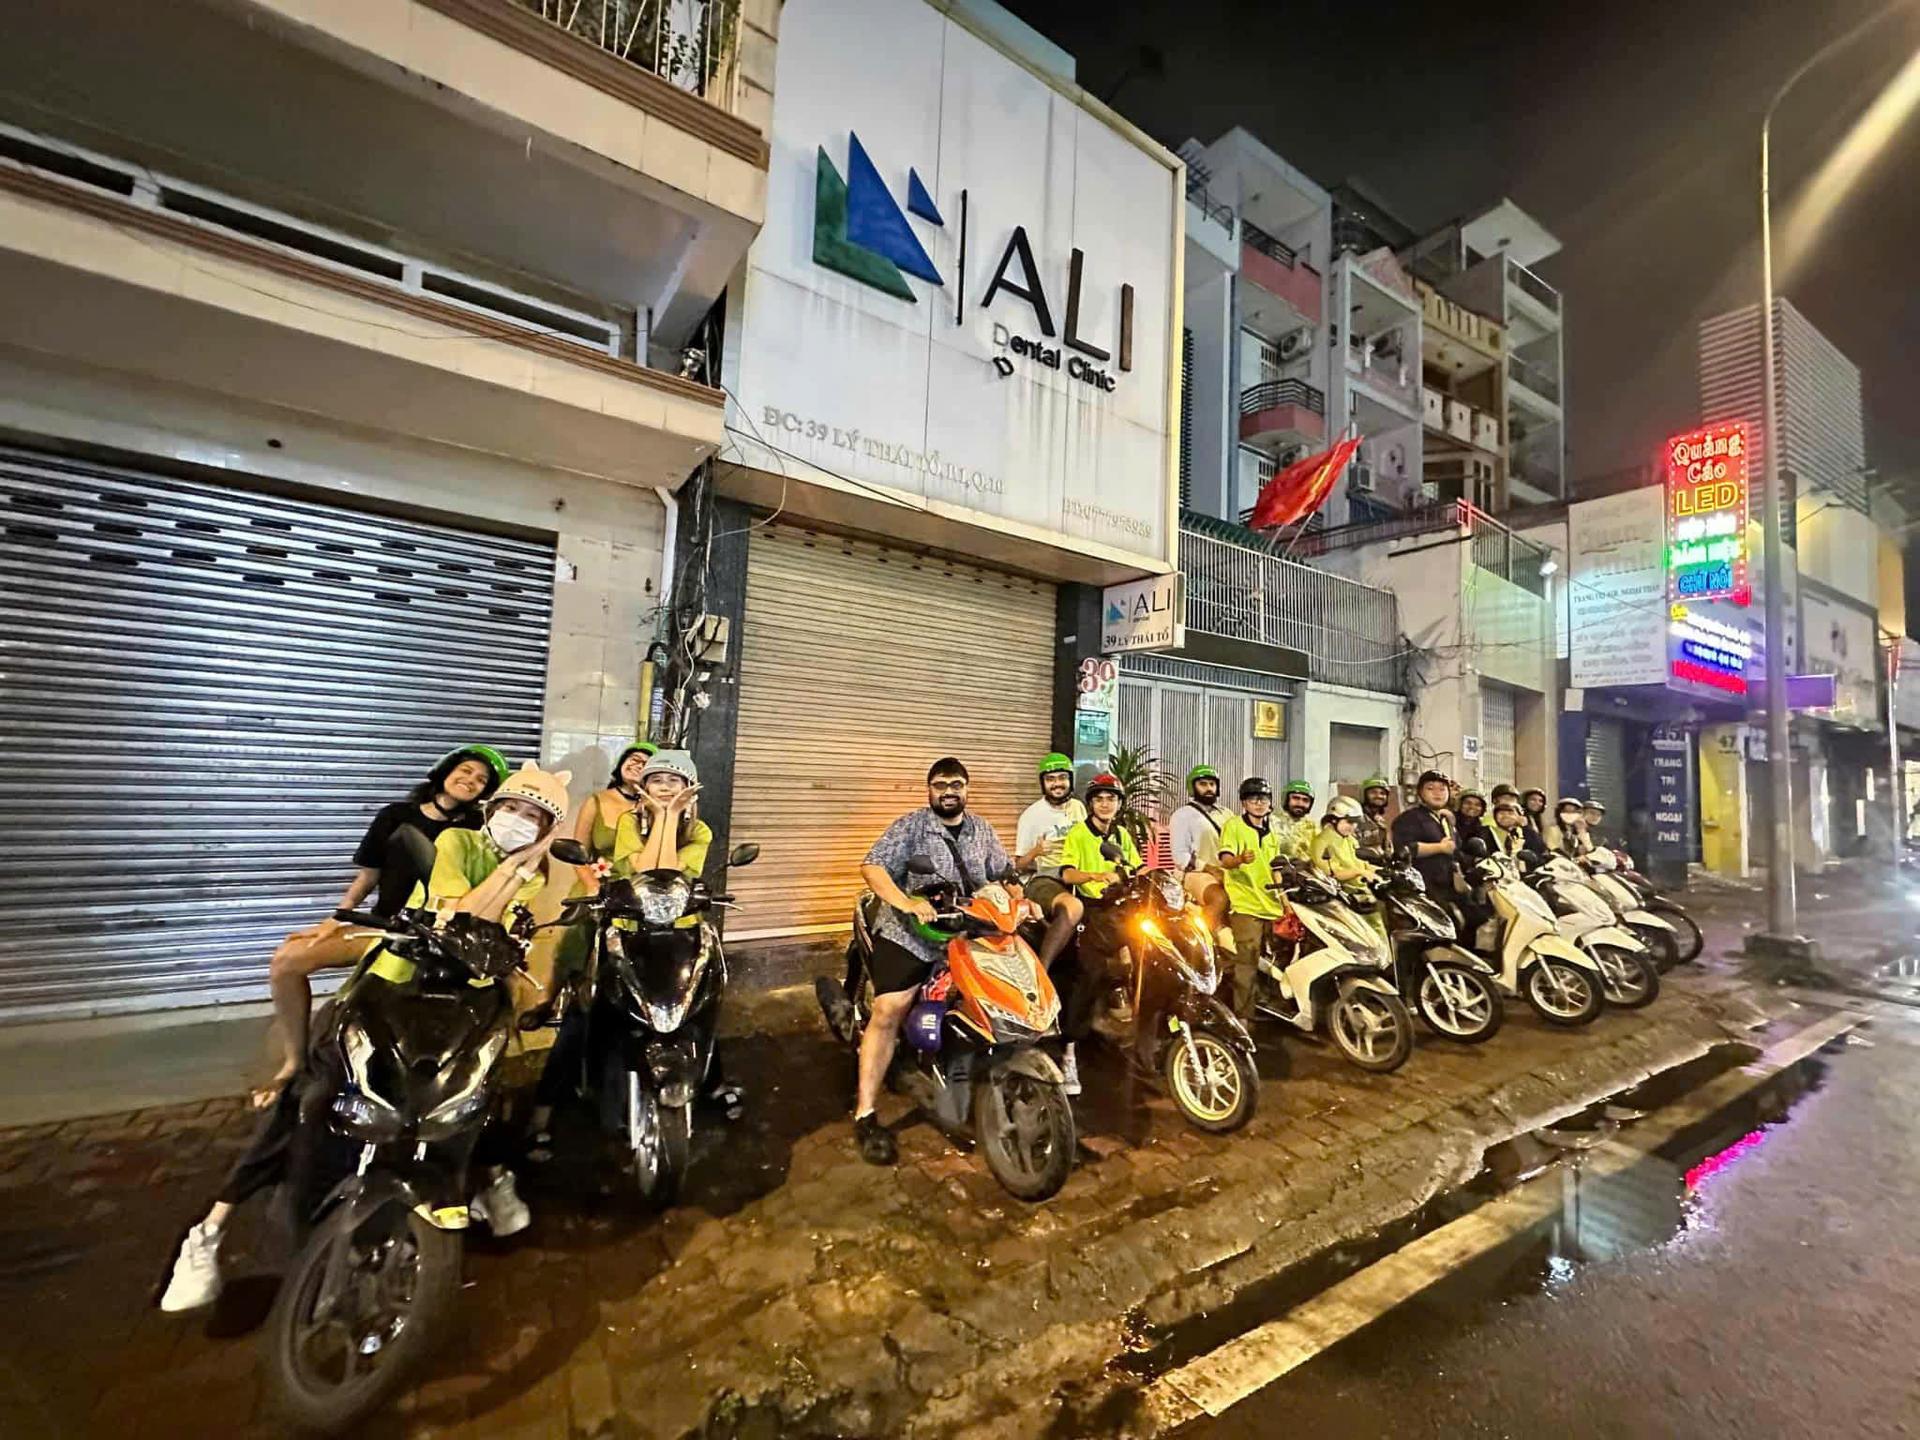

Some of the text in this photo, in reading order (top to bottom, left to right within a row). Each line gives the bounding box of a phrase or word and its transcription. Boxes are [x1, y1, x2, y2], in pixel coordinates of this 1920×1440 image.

[980, 225, 1134, 373] ALI
[1067, 355, 1116, 393] Clinic
[805, 419, 829, 441] 39
[832, 426, 861, 452] LÝ
[1674, 431, 1742, 467] Quảng
[1687, 458, 1727, 484] Cáo
[1676, 481, 1739, 517] LED
[1133, 588, 1171, 615] ALI
[1103, 634, 1117, 649] 39
[1081, 656, 1116, 694] 39
